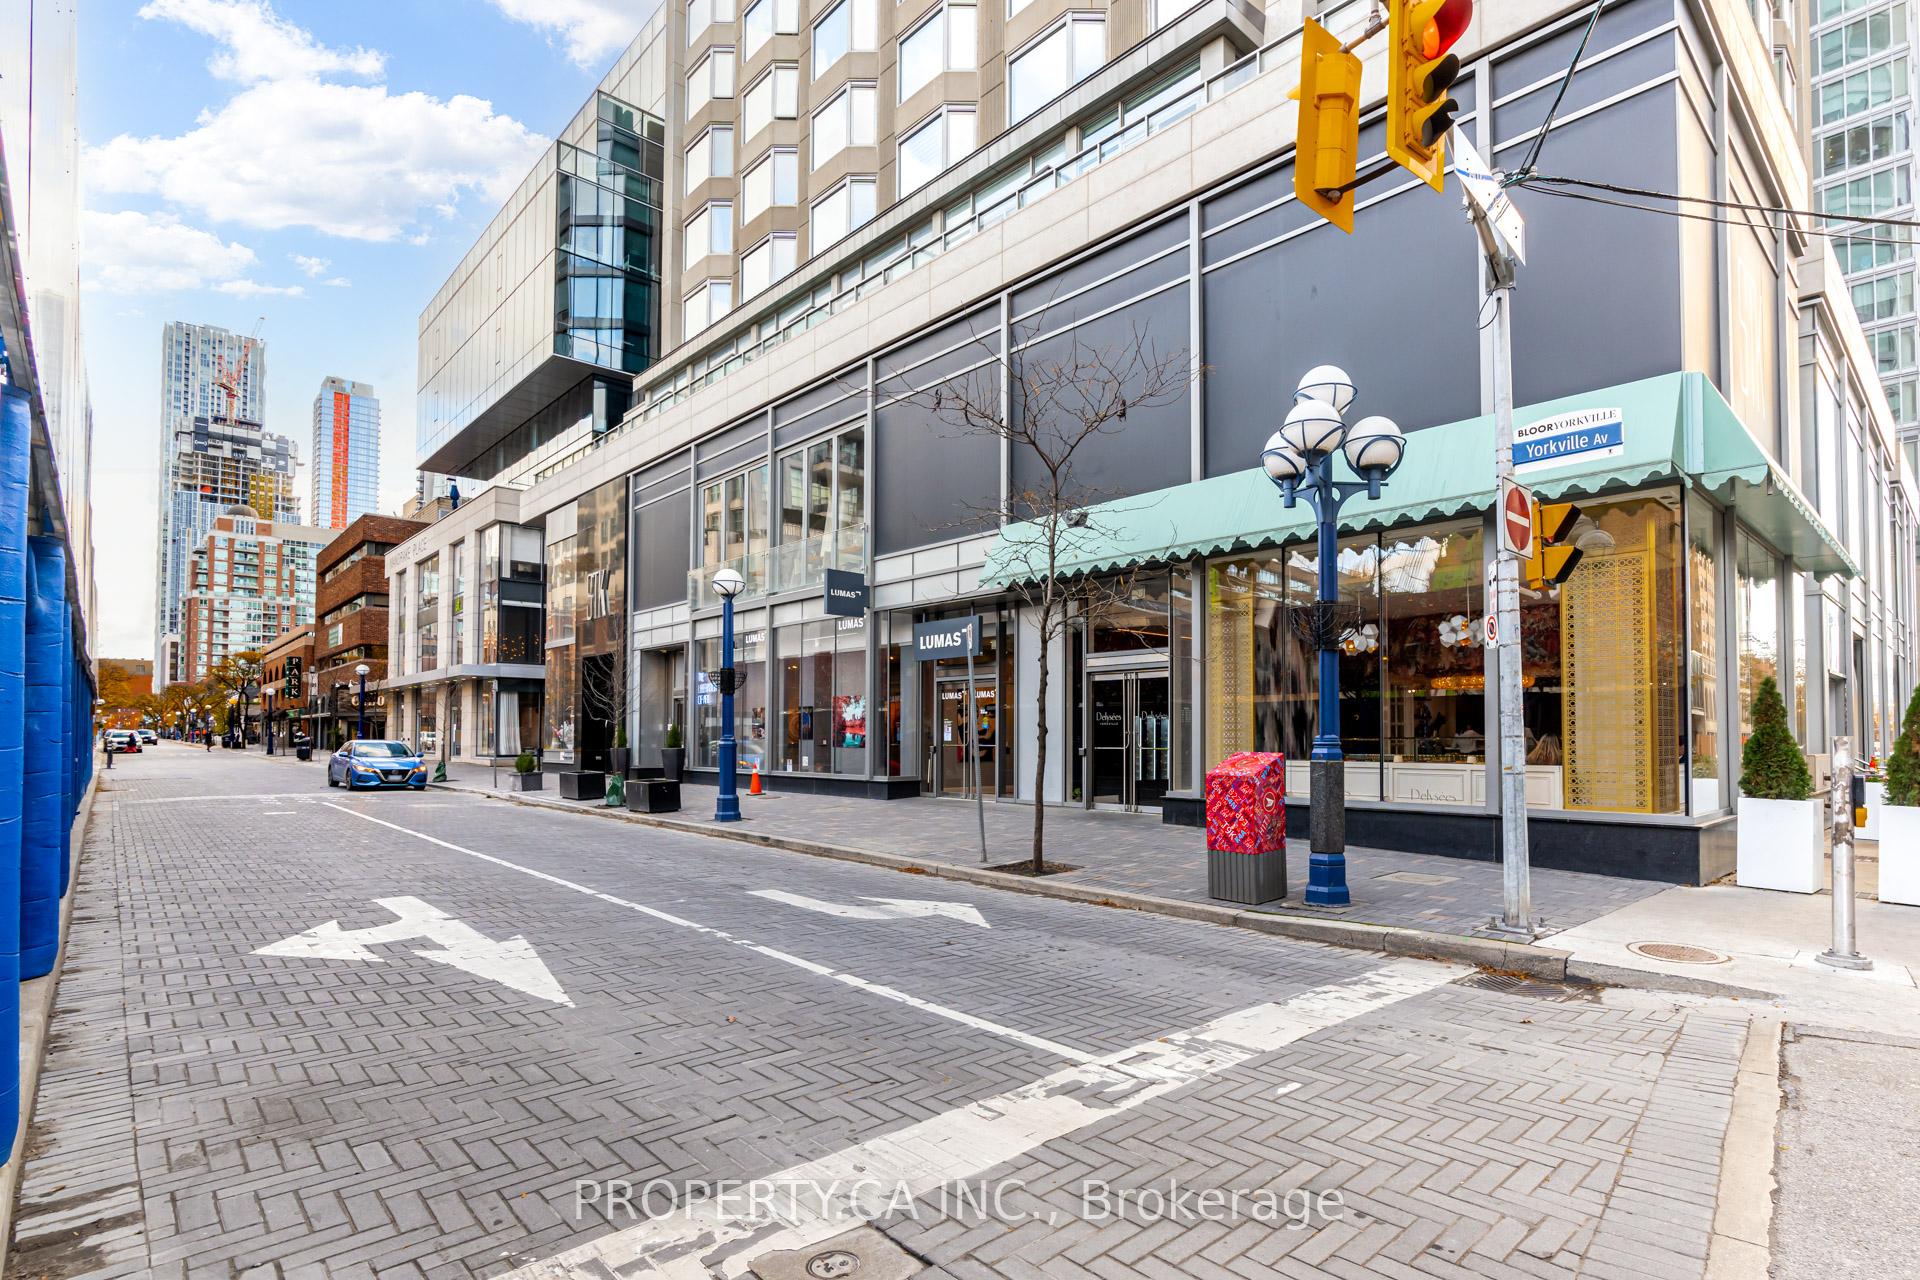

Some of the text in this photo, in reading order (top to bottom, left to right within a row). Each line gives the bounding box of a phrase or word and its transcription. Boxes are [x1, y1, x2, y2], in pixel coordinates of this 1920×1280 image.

[1526, 433, 1608, 458] Yorkville Av
[830, 588, 856, 599] LUMAS
[838, 617, 864, 631] LUMAS
[745, 632, 765, 644] LUMAS
[919, 631, 962, 650] LUMAS
[291, 657, 299, 696] PARK
[941, 691, 962, 700] LUMAS
